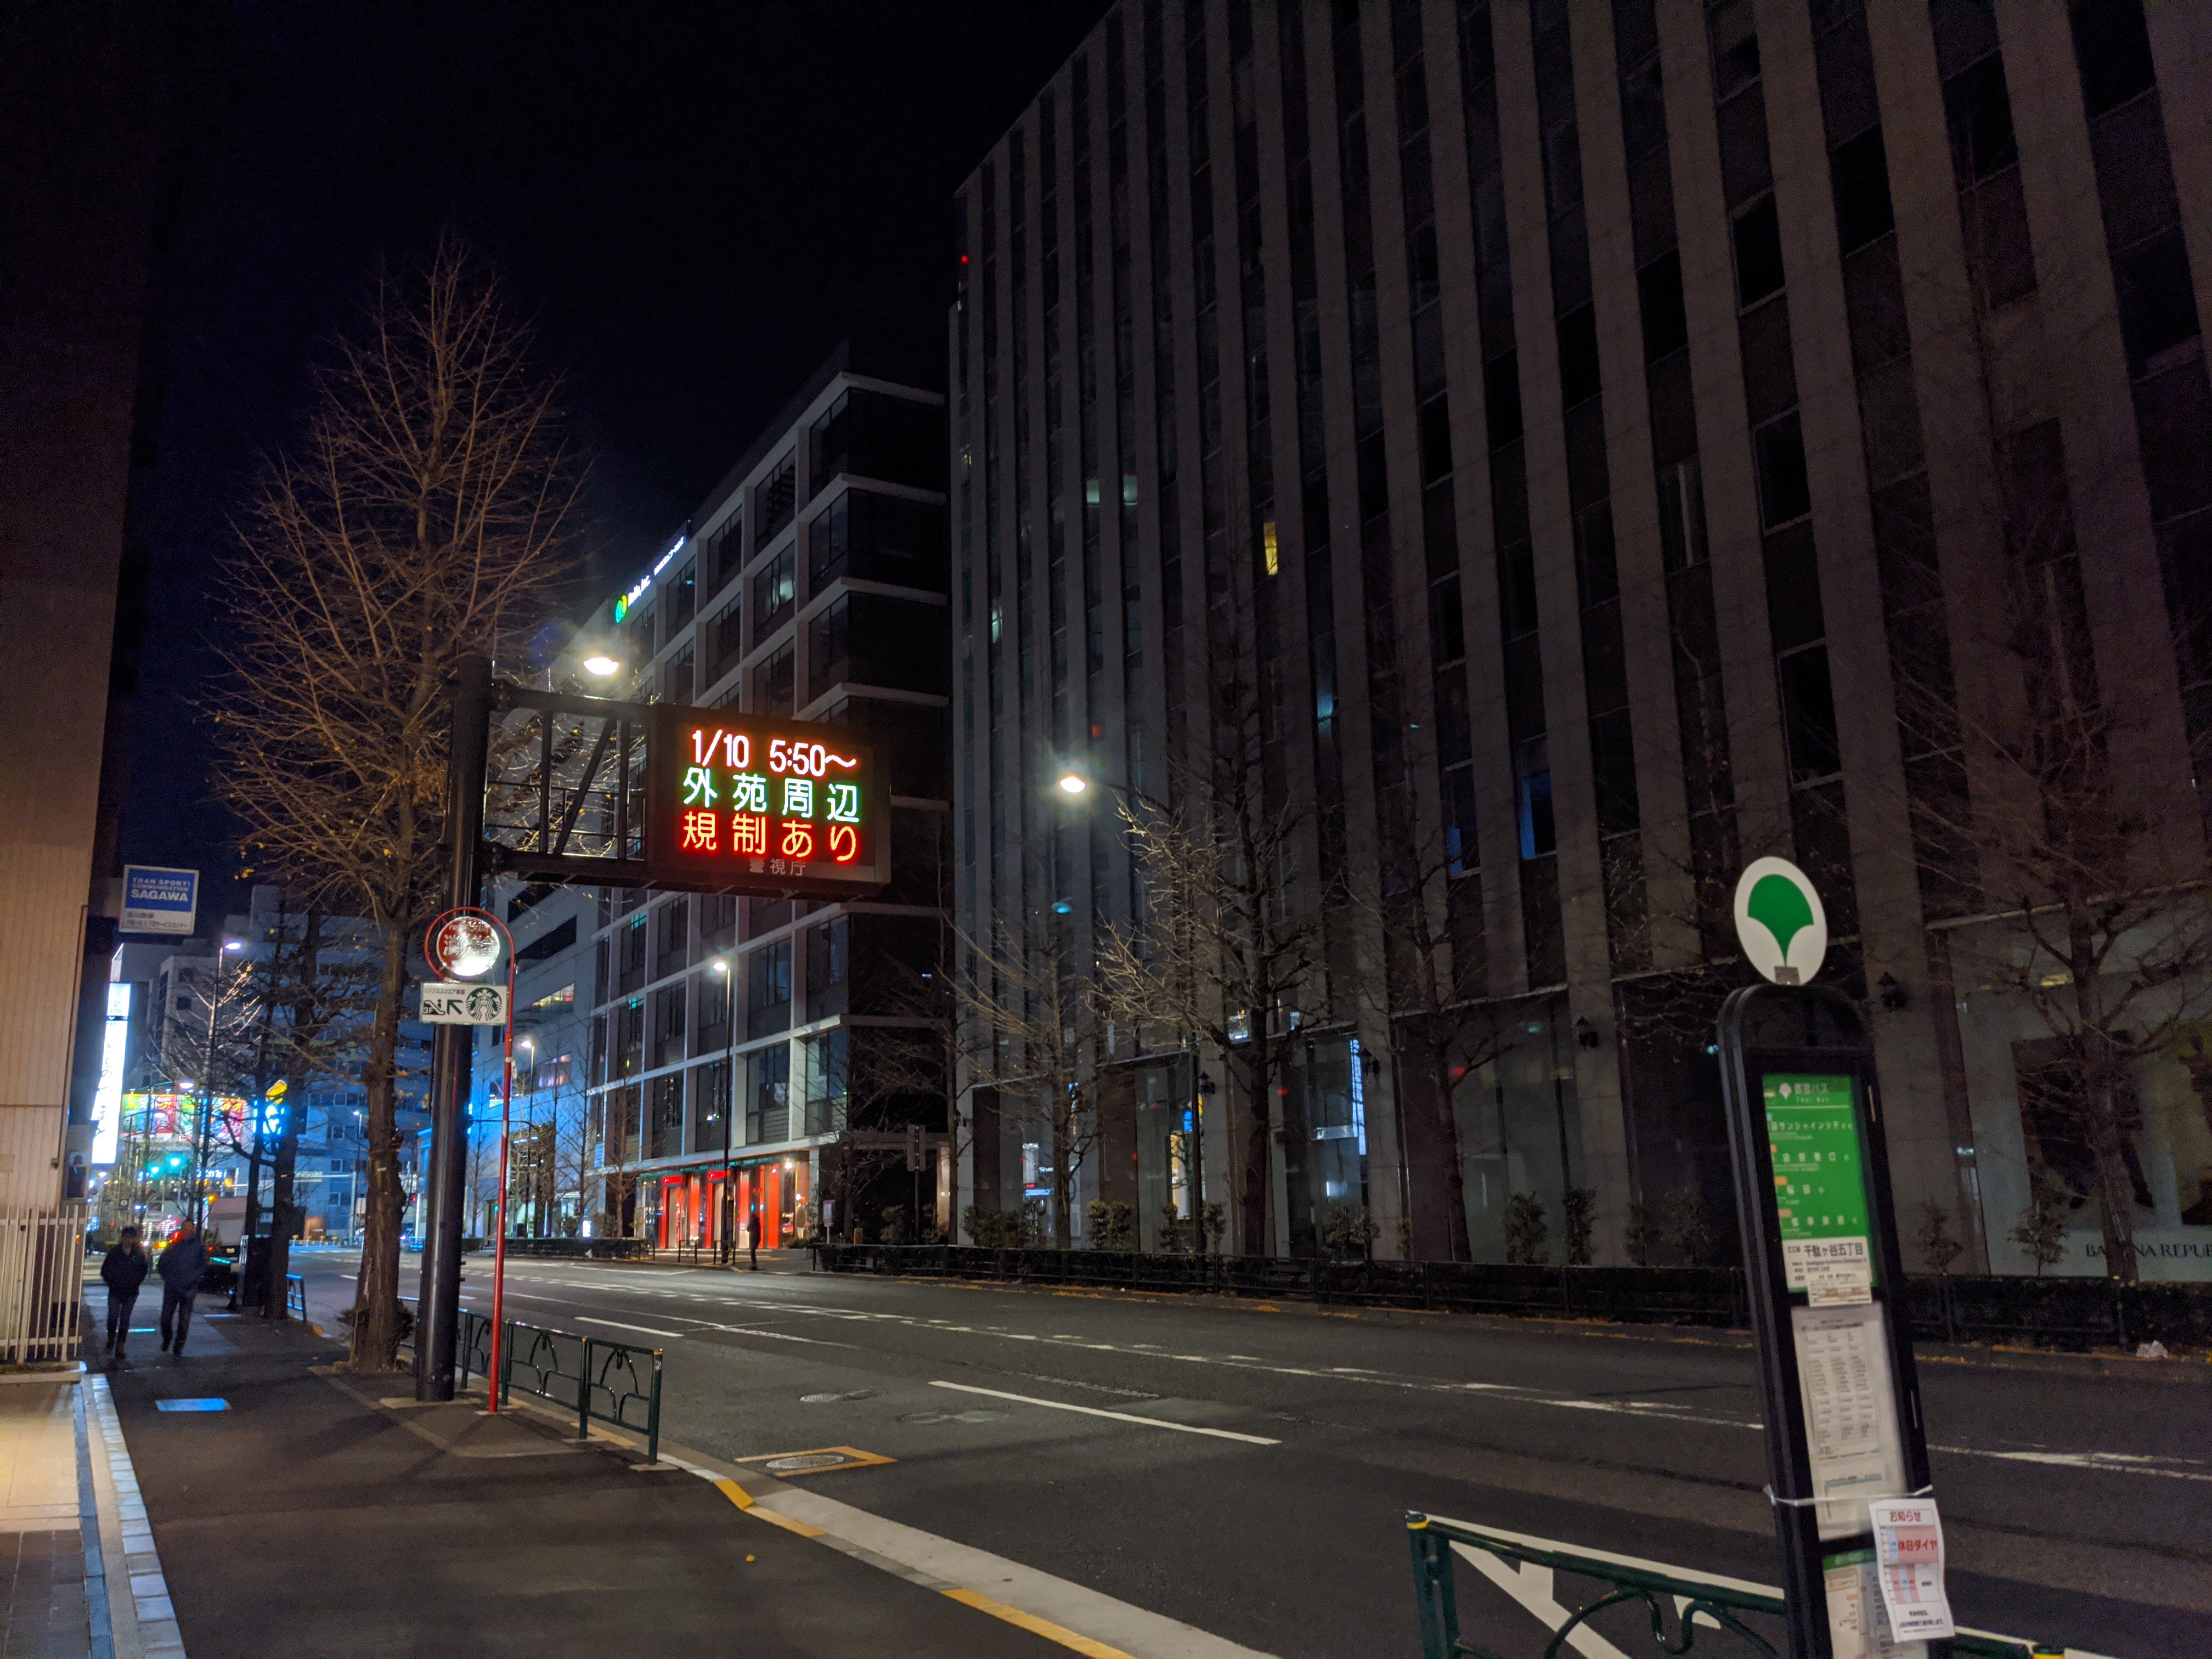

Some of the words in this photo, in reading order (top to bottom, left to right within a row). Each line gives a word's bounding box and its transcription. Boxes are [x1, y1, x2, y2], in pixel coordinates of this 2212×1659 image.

[692, 729, 749, 768] 1/10
[683, 767, 859, 822] 外苑周辺
[682, 810, 856, 861] 規制あり
[749, 857, 806, 876] 警視庁
[131, 889, 189, 902] SAGAWA
[2086, 1244, 2157, 1257] BANA
[1889, 1510, 1922, 1522] お知らせ
